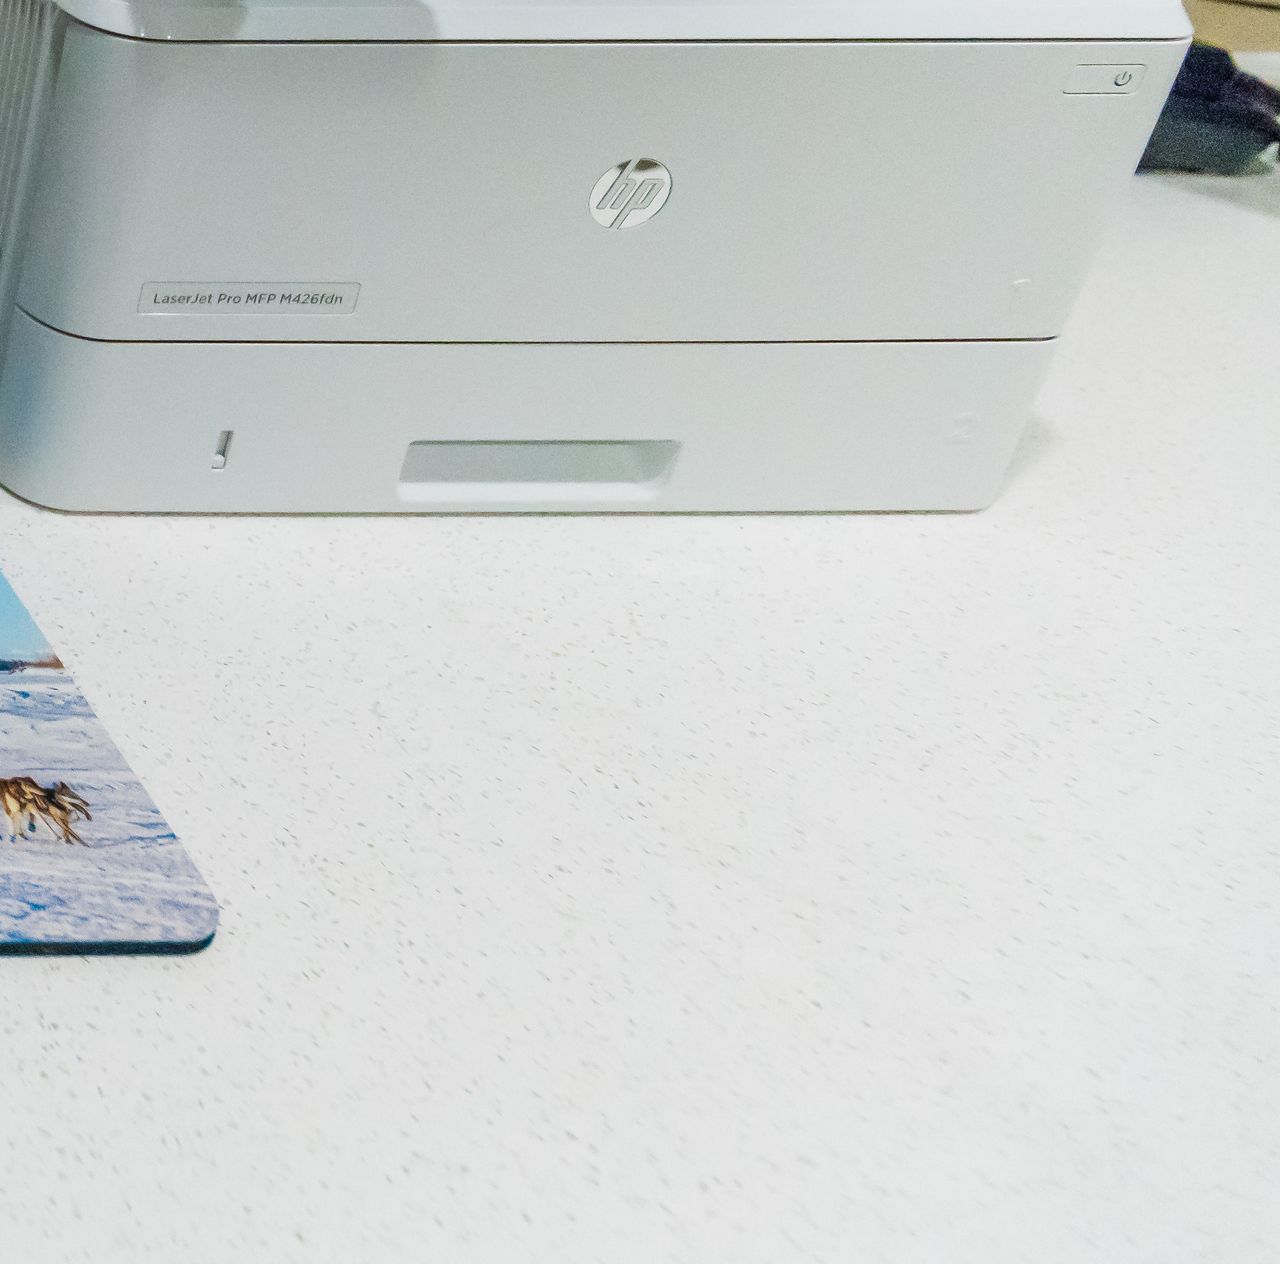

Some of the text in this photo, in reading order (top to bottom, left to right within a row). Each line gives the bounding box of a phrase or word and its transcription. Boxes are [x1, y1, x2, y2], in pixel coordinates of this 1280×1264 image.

[594, 158, 668, 230] hp
[153, 293, 343, 305] LaserJet Pro MFP M426fdn
